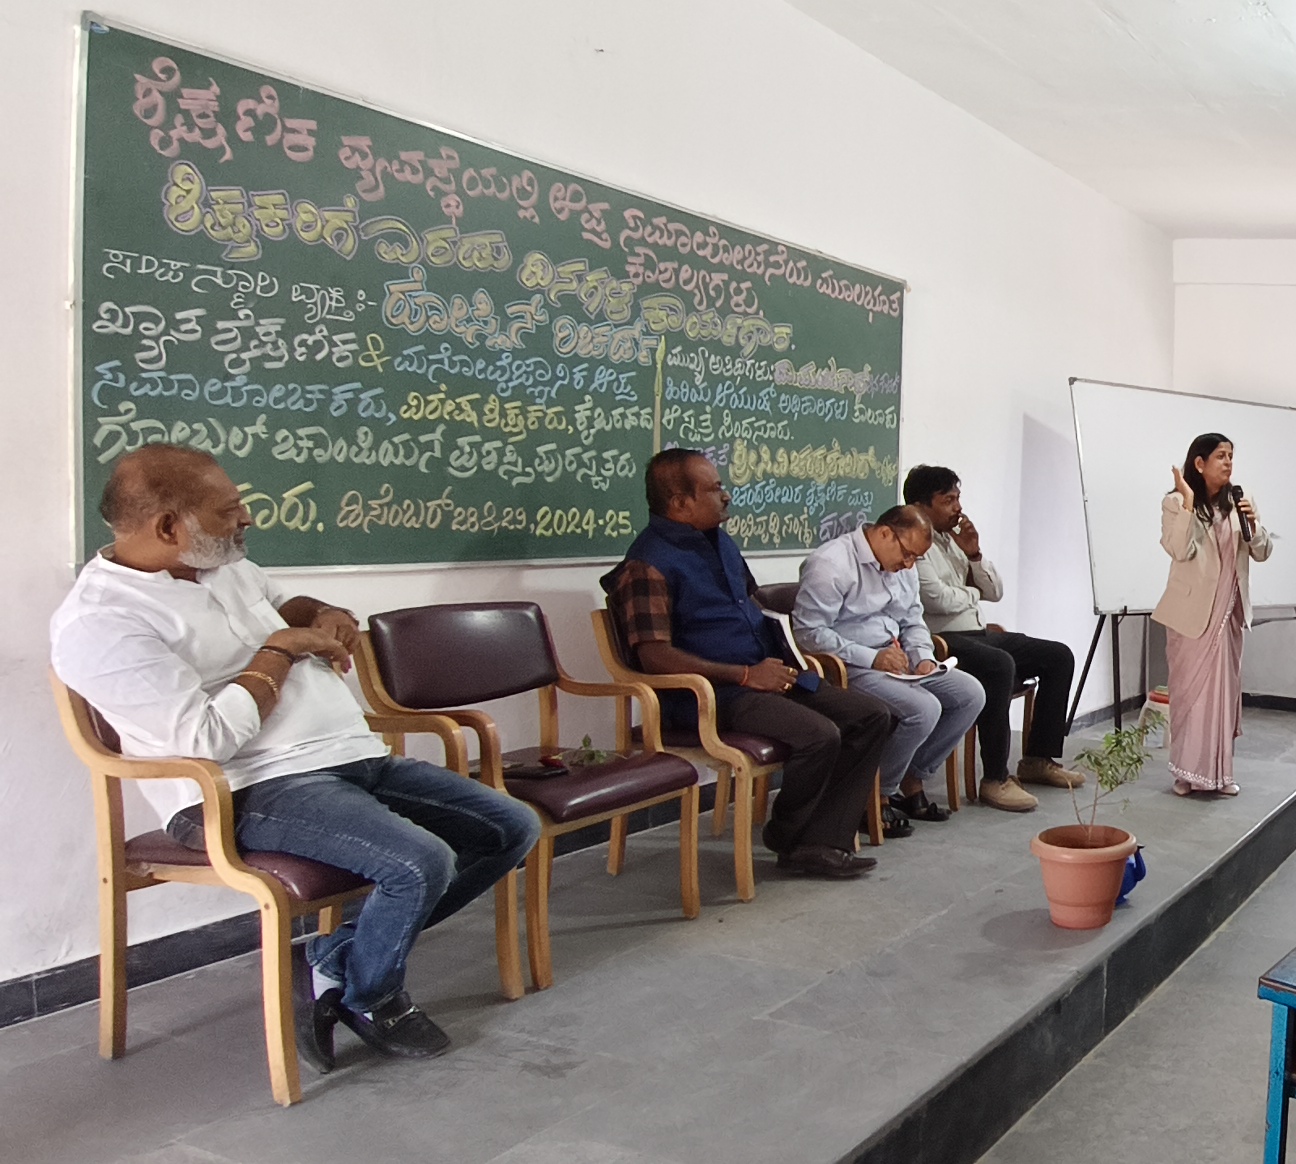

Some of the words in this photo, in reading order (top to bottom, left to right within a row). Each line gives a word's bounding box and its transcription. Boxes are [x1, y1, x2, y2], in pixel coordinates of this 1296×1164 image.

[133, 57, 317, 163] ಶೈಕ್ಷಣಿಕ
[816, 270, 900, 323] ಮೂಲಭೂತ
[359, 216, 512, 272] ಎರಡು
[517, 251, 637, 323] ದಿನಗಳ
[92, 301, 207, 370] ಖ್ಯಾತ
[210, 309, 359, 374] ಶೈಕ್ಷಣಿಕ
[358, 334, 391, 372] &
[336, 482, 454, 534] ಡಿಸೆಂಬರ್
